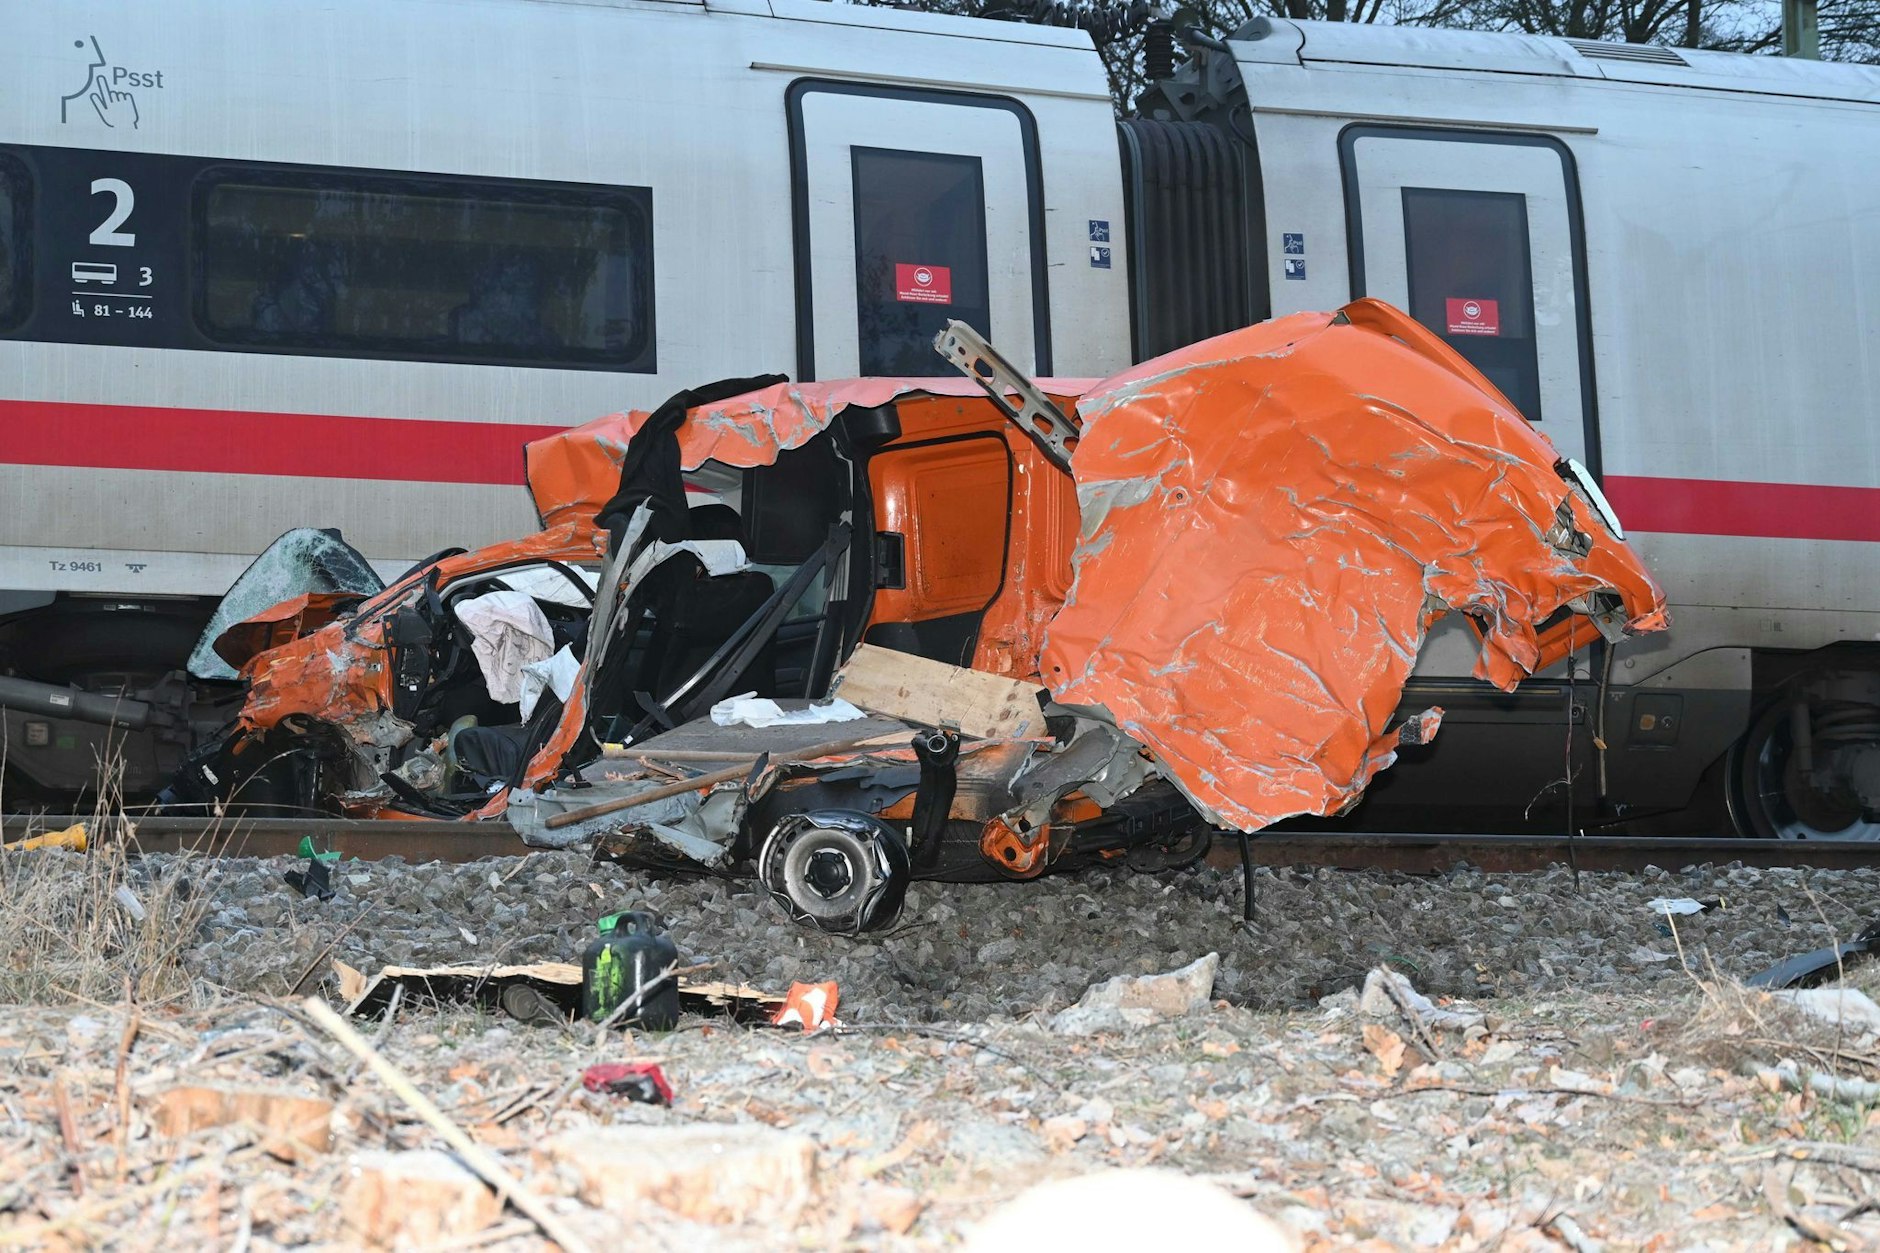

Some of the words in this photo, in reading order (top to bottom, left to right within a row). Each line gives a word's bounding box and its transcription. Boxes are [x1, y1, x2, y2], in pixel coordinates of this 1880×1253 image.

[112, 66, 164, 89] Psst
[89, 177, 136, 247] 2
[138, 266, 153, 287] 3
[94, 304, 110, 317] 81
[128, 305, 153, 319] 144
[49, 560, 66, 571] Tz
[70, 561, 102, 572] 9461
